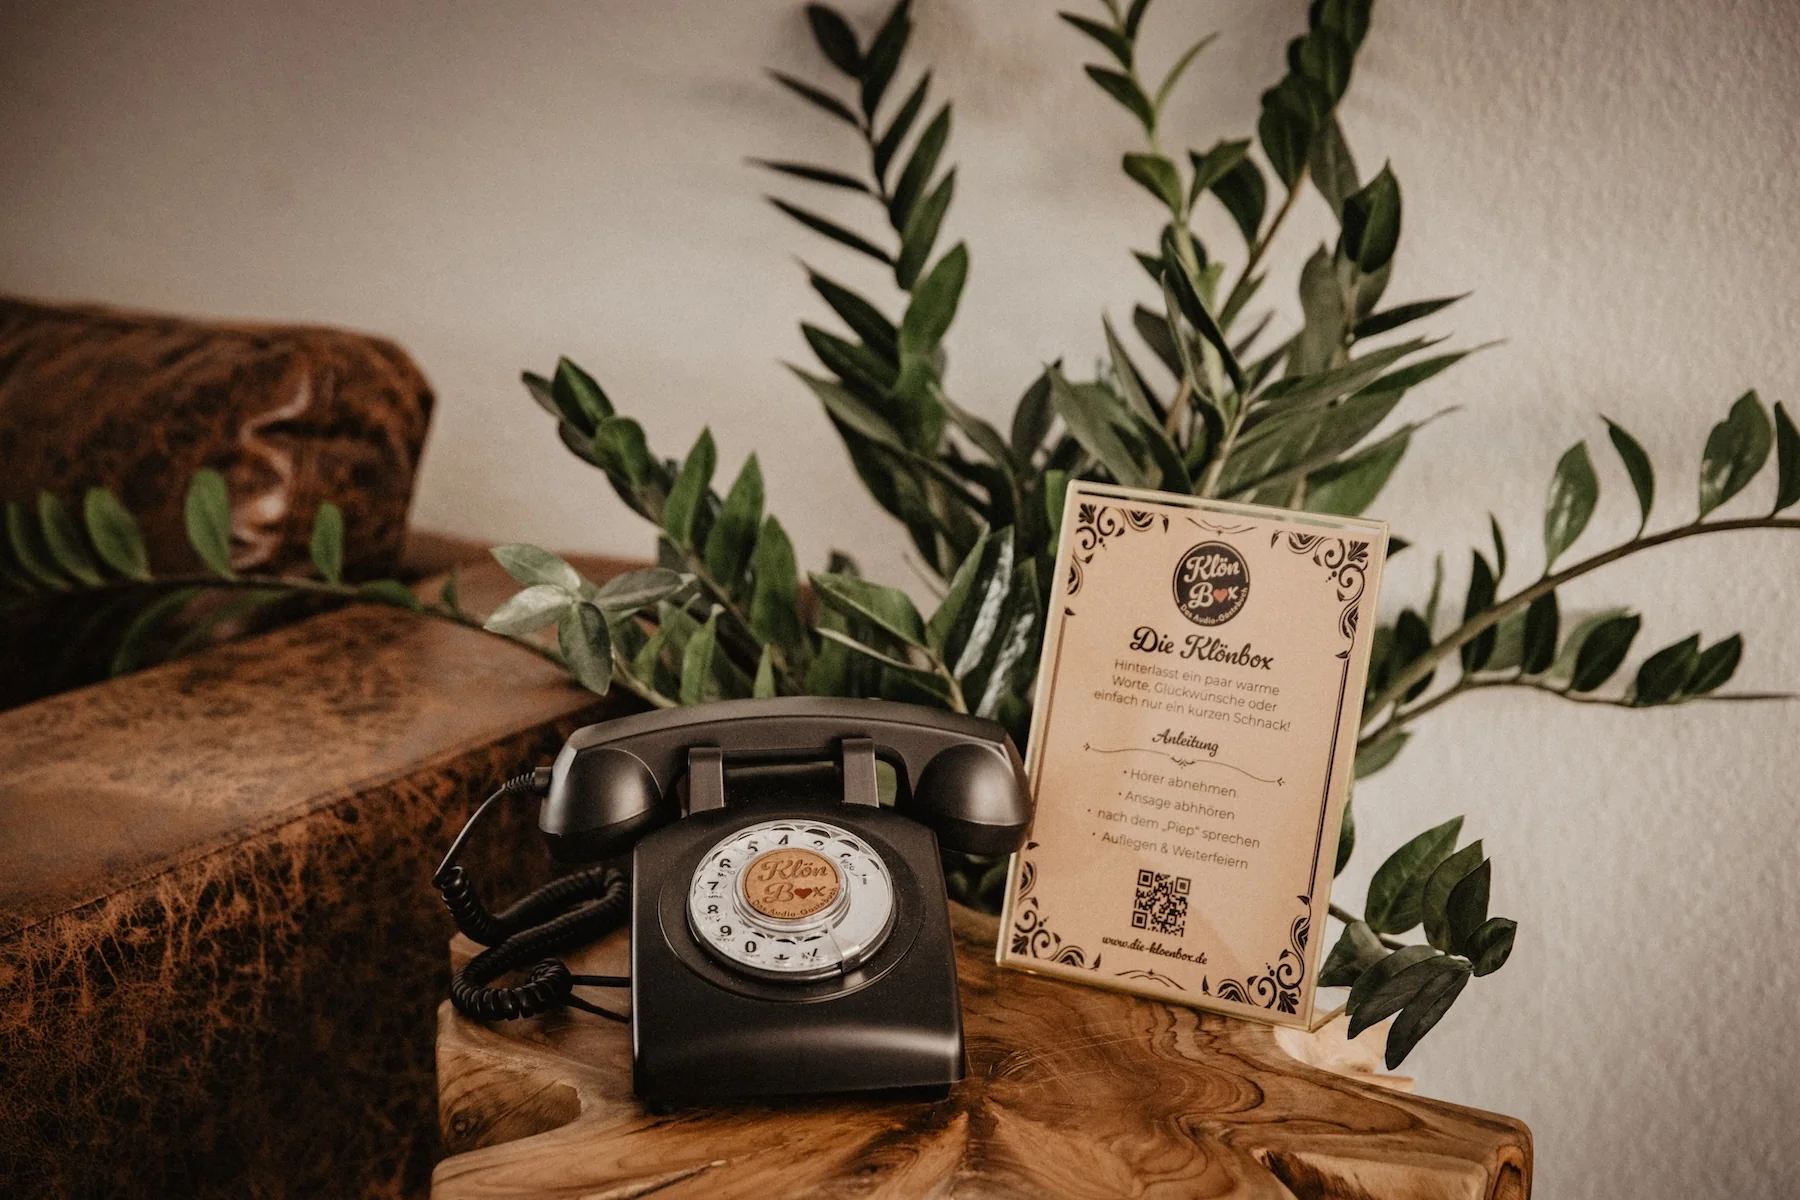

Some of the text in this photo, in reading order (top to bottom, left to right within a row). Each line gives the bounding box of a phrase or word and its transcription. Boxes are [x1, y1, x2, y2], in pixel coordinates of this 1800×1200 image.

[1183, 553, 1240, 583] Klön
[1129, 626, 1274, 671] Die Klönbox
[1114, 658, 1280, 696] Hinterlasst ein paar warme
[1111, 674, 1151, 693] Worte,
[1248, 699, 1278, 712] oder
[1093, 689, 1291, 732] einfach nur ein kurzen Schnack!
[1152, 728, 1219, 758] Anleitung
[1124, 790, 1171, 810] Ansage
[1167, 776, 1237, 798] abnehmen
[1097, 809, 1128, 823] nach
[1130, 814, 1159, 830] dem
[1202, 829, 1260, 849] sprechen
[1101, 831, 1249, 870] Auflegen & Weiterfeiern
[757, 859, 828, 882] Klön
[707, 881, 719, 891] 7
[707, 904, 719, 914] 8
[720, 925, 732, 937] 9
[744, 940, 757, 953] 0
[1102, 935, 1208, 965] www.die-kloenbox.de
